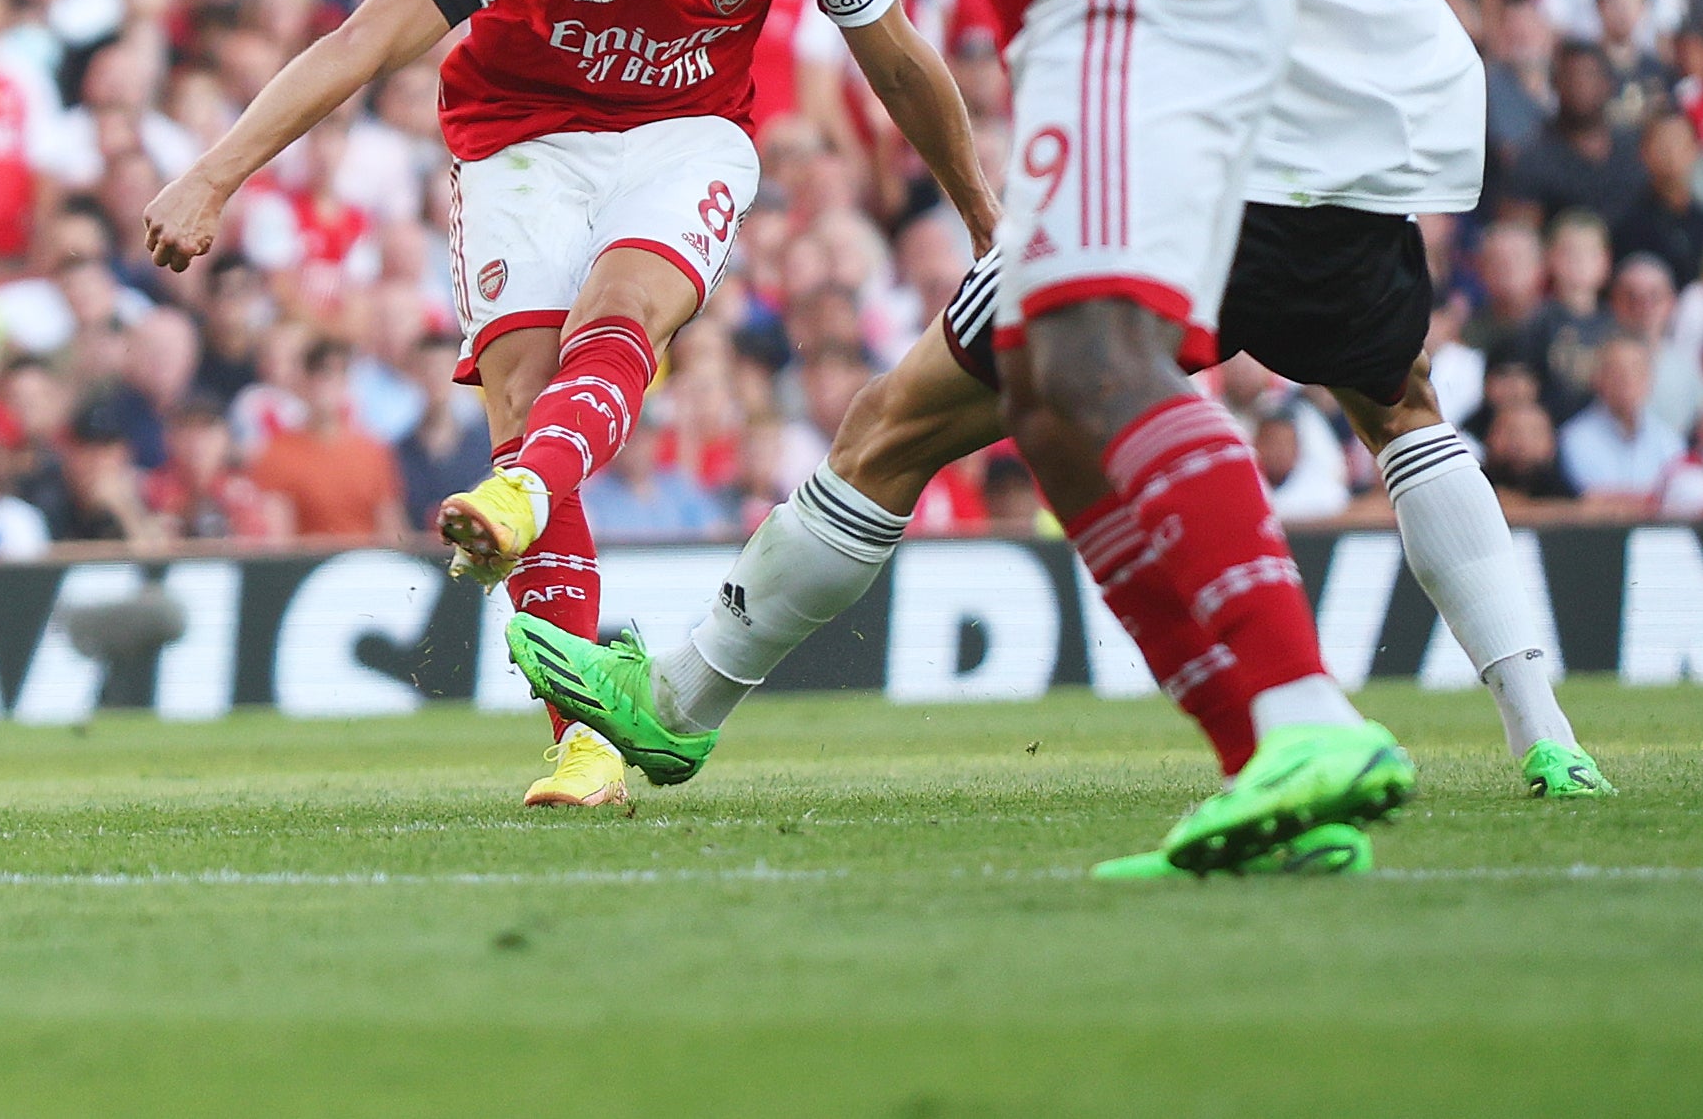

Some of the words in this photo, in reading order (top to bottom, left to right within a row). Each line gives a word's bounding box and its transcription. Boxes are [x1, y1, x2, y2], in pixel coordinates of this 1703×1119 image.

[577, 54, 618, 83] FLY
[621, 46, 715, 89] BETTER
[1024, 128, 1070, 213] 9
[698, 180, 735, 242] 8
[681, 232, 711, 267] adidas
[570, 391, 617, 445] AFC
[520, 584, 586, 609] AFC
